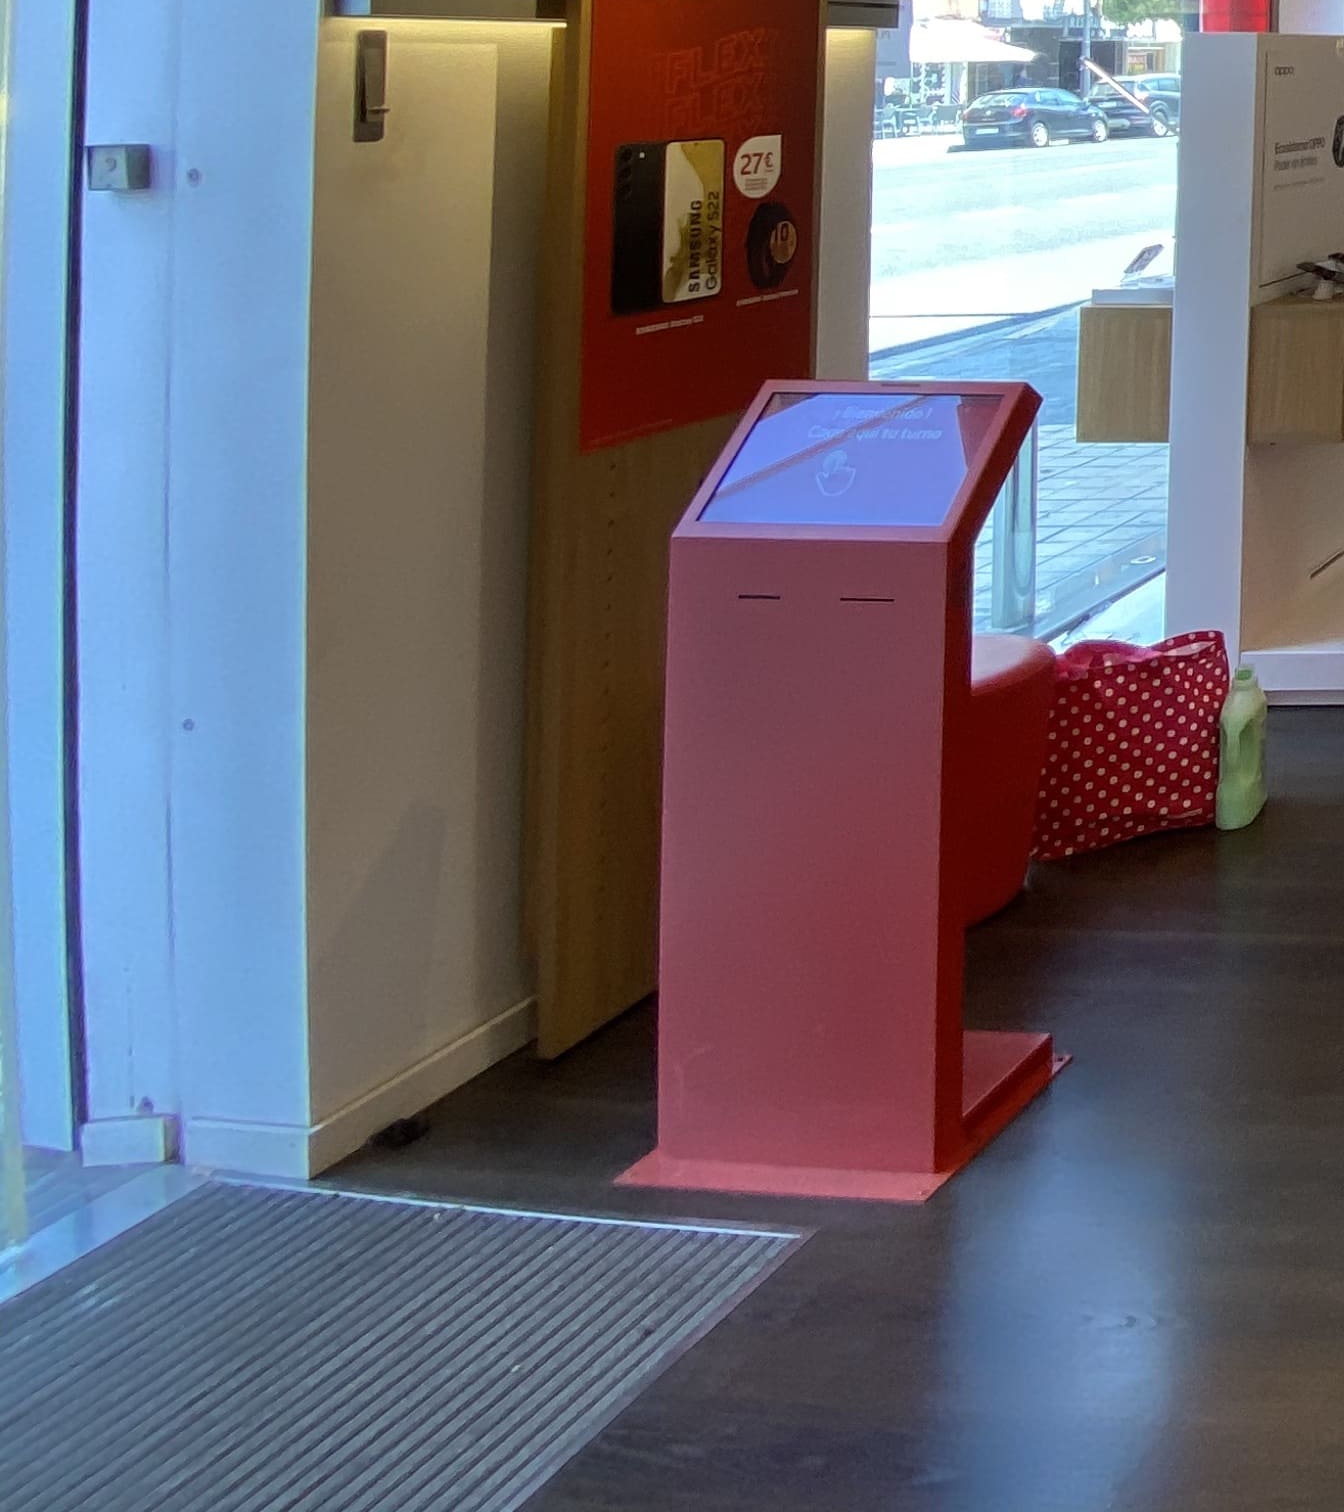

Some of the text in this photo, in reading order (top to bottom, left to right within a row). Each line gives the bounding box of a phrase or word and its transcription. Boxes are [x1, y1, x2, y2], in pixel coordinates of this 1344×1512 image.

[740, 152, 774, 175] 27€
[688, 200, 703, 293] SAMSUNG
[705, 191, 721, 291] Galaxy S22
